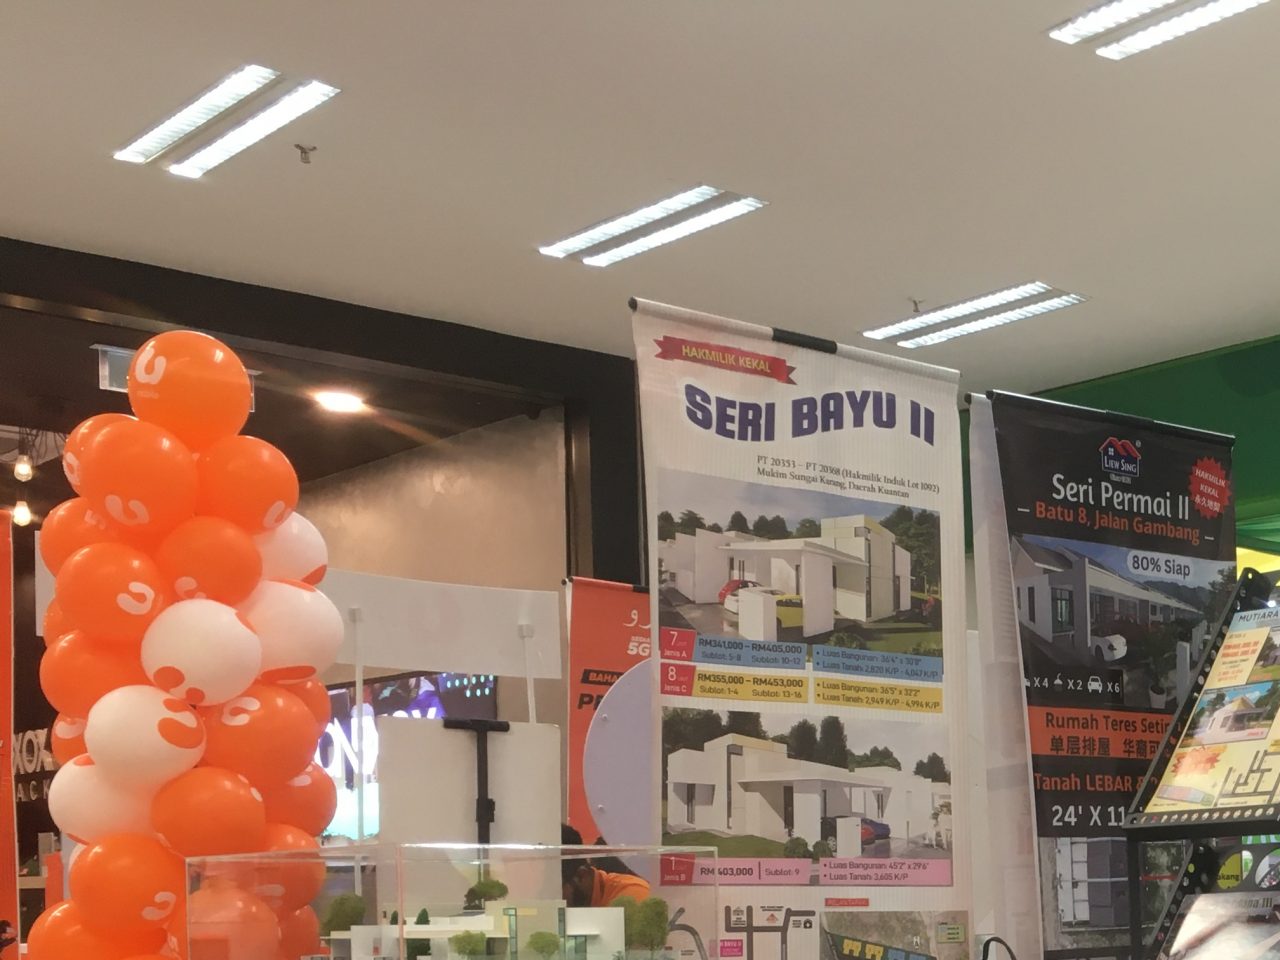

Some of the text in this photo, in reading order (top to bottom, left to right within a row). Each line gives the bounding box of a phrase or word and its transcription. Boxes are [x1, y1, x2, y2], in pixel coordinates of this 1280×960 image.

[681, 345, 772, 373] HAKMILIK KEKAL
[684, 383, 935, 447] SERI BAYU II
[757, 455, 767, 465] PT
[771, 457, 796, 468] 20353
[805, 462, 816, 472] PT
[842, 466, 881, 483] (Hakmilik
[884, 476, 905, 488] Induk
[1104, 456, 1137, 473] LIEW SING
[757, 467, 787, 480] Mukim
[789, 471, 818, 484] Sungai
[848, 481, 876, 494] Daerah
[877, 486, 910, 499] Kuantan
[1195, 469, 1226, 488] HAKMILIK
[1051, 473, 1189, 521] Seri Permai II
[1200, 483, 1219, 498] KEKAL
[1035, 501, 1200, 546] Batu 8, Jalan Gambang
[1131, 555, 1191, 579] 80% Siap
[1239, 610, 1279, 622] MUTIARA
[669, 631, 679, 646] 7
[698, 638, 744, 650] RM341,000
[751, 643, 802, 654] RM405,000
[627, 641, 651, 657] 5G
[668, 666, 677, 681] 8
[697, 673, 744, 685] RM355,000
[752, 677, 804, 688] RM453,000
[822, 682, 841, 690] Luas
[1045, 712, 1099, 731] Rumah
[1102, 715, 1137, 733] Teres
[1034, 772, 1081, 792] Tanah
[1085, 773, 1133, 792] LEBAR
[1051, 804, 1102, 827] 24' X
[700, 867, 715, 876] RM
[829, 861, 848, 870] Luas
[829, 873, 848, 881] Luas
